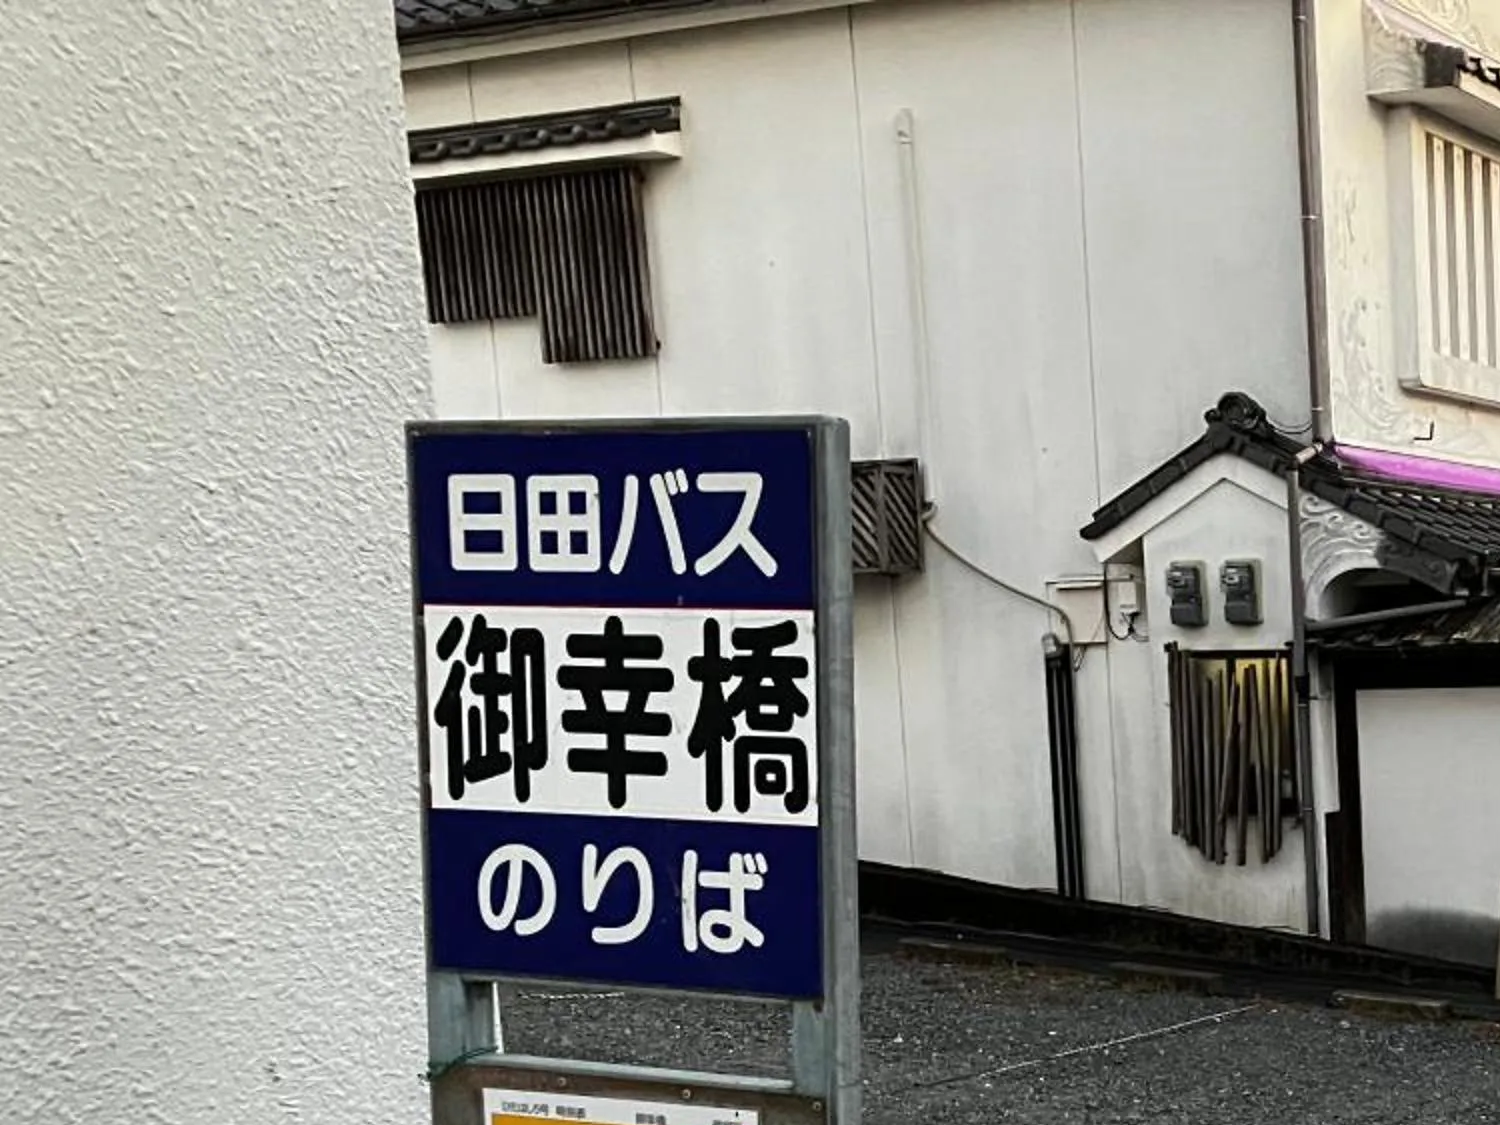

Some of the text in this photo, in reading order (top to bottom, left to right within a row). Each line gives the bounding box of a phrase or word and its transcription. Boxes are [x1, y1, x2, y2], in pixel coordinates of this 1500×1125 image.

[447, 468, 778, 577] 日田バス
[434, 613, 809, 815] 御幸橋
[478, 843, 768, 953] のりば
